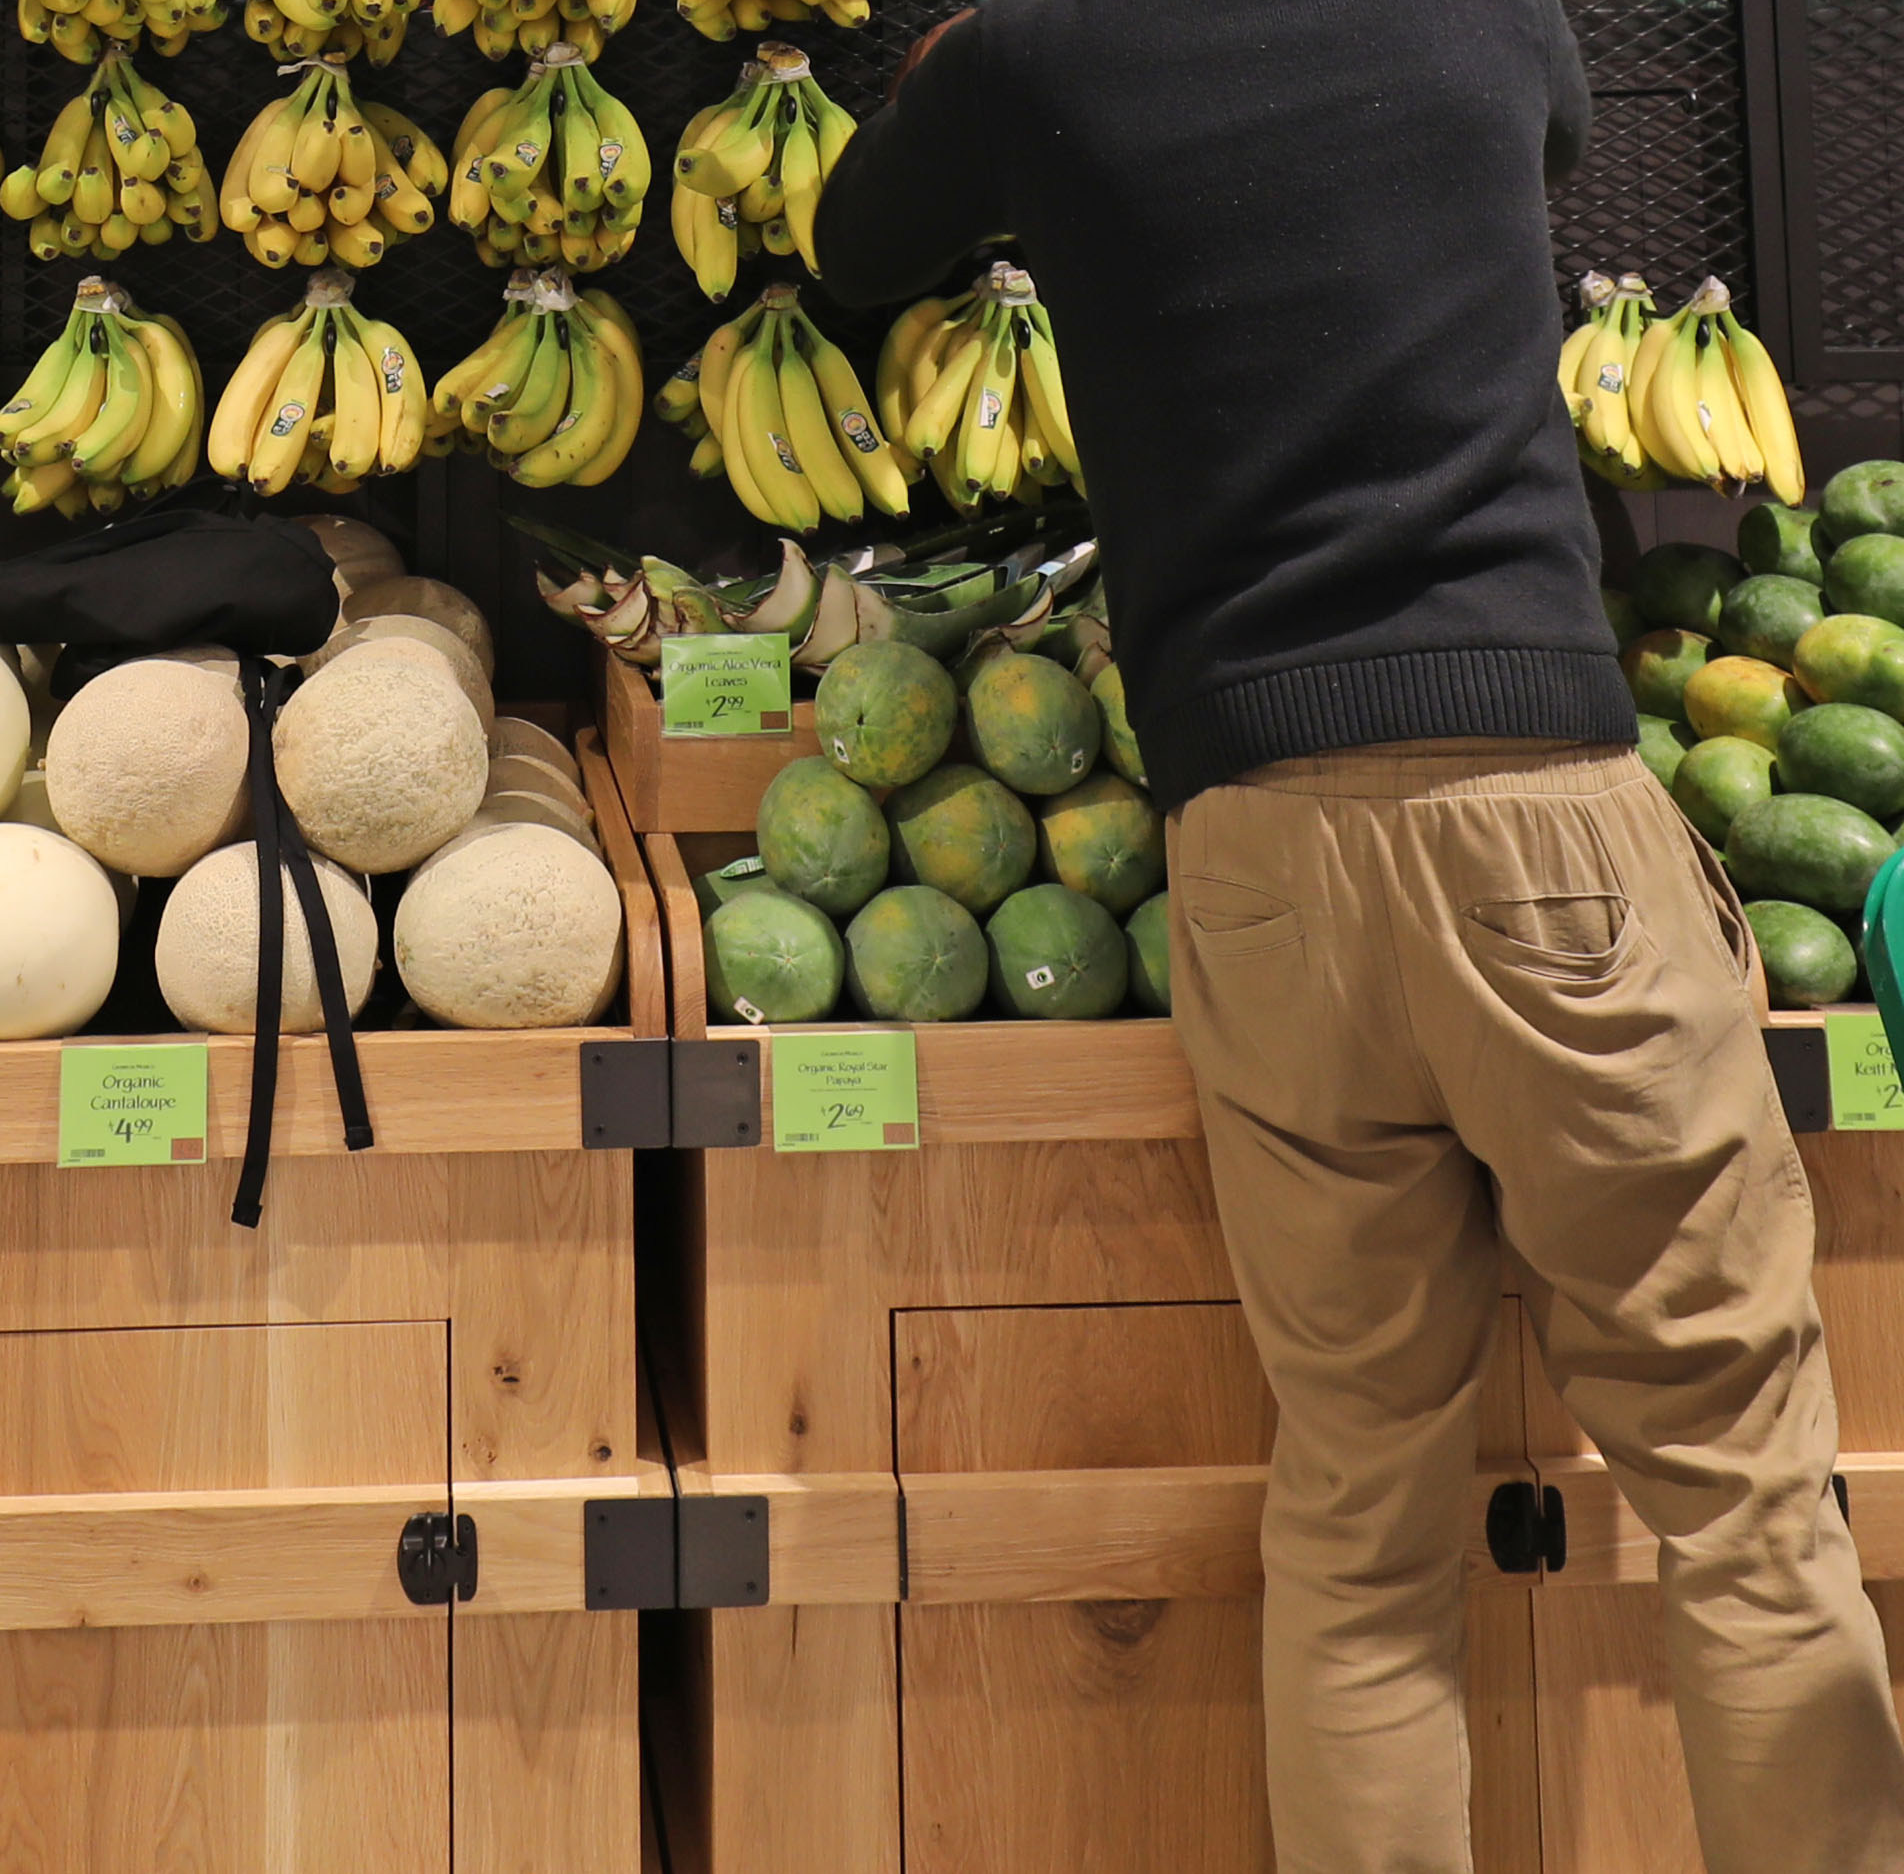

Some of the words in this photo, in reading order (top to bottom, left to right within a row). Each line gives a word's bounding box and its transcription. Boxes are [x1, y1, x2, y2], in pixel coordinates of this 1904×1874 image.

[669, 661, 719, 675] Organic
[722, 659, 749, 671] Aloe
[751, 658, 782, 670] Vera
[798, 1064, 835, 1076] Organic
[838, 1062, 865, 1074] Royal
[867, 1062, 888, 1071] Star
[102, 1075, 165, 1093] Organic
[826, 1076, 862, 1087] Papaya
[90, 1094, 176, 1111] Cantaloupe
